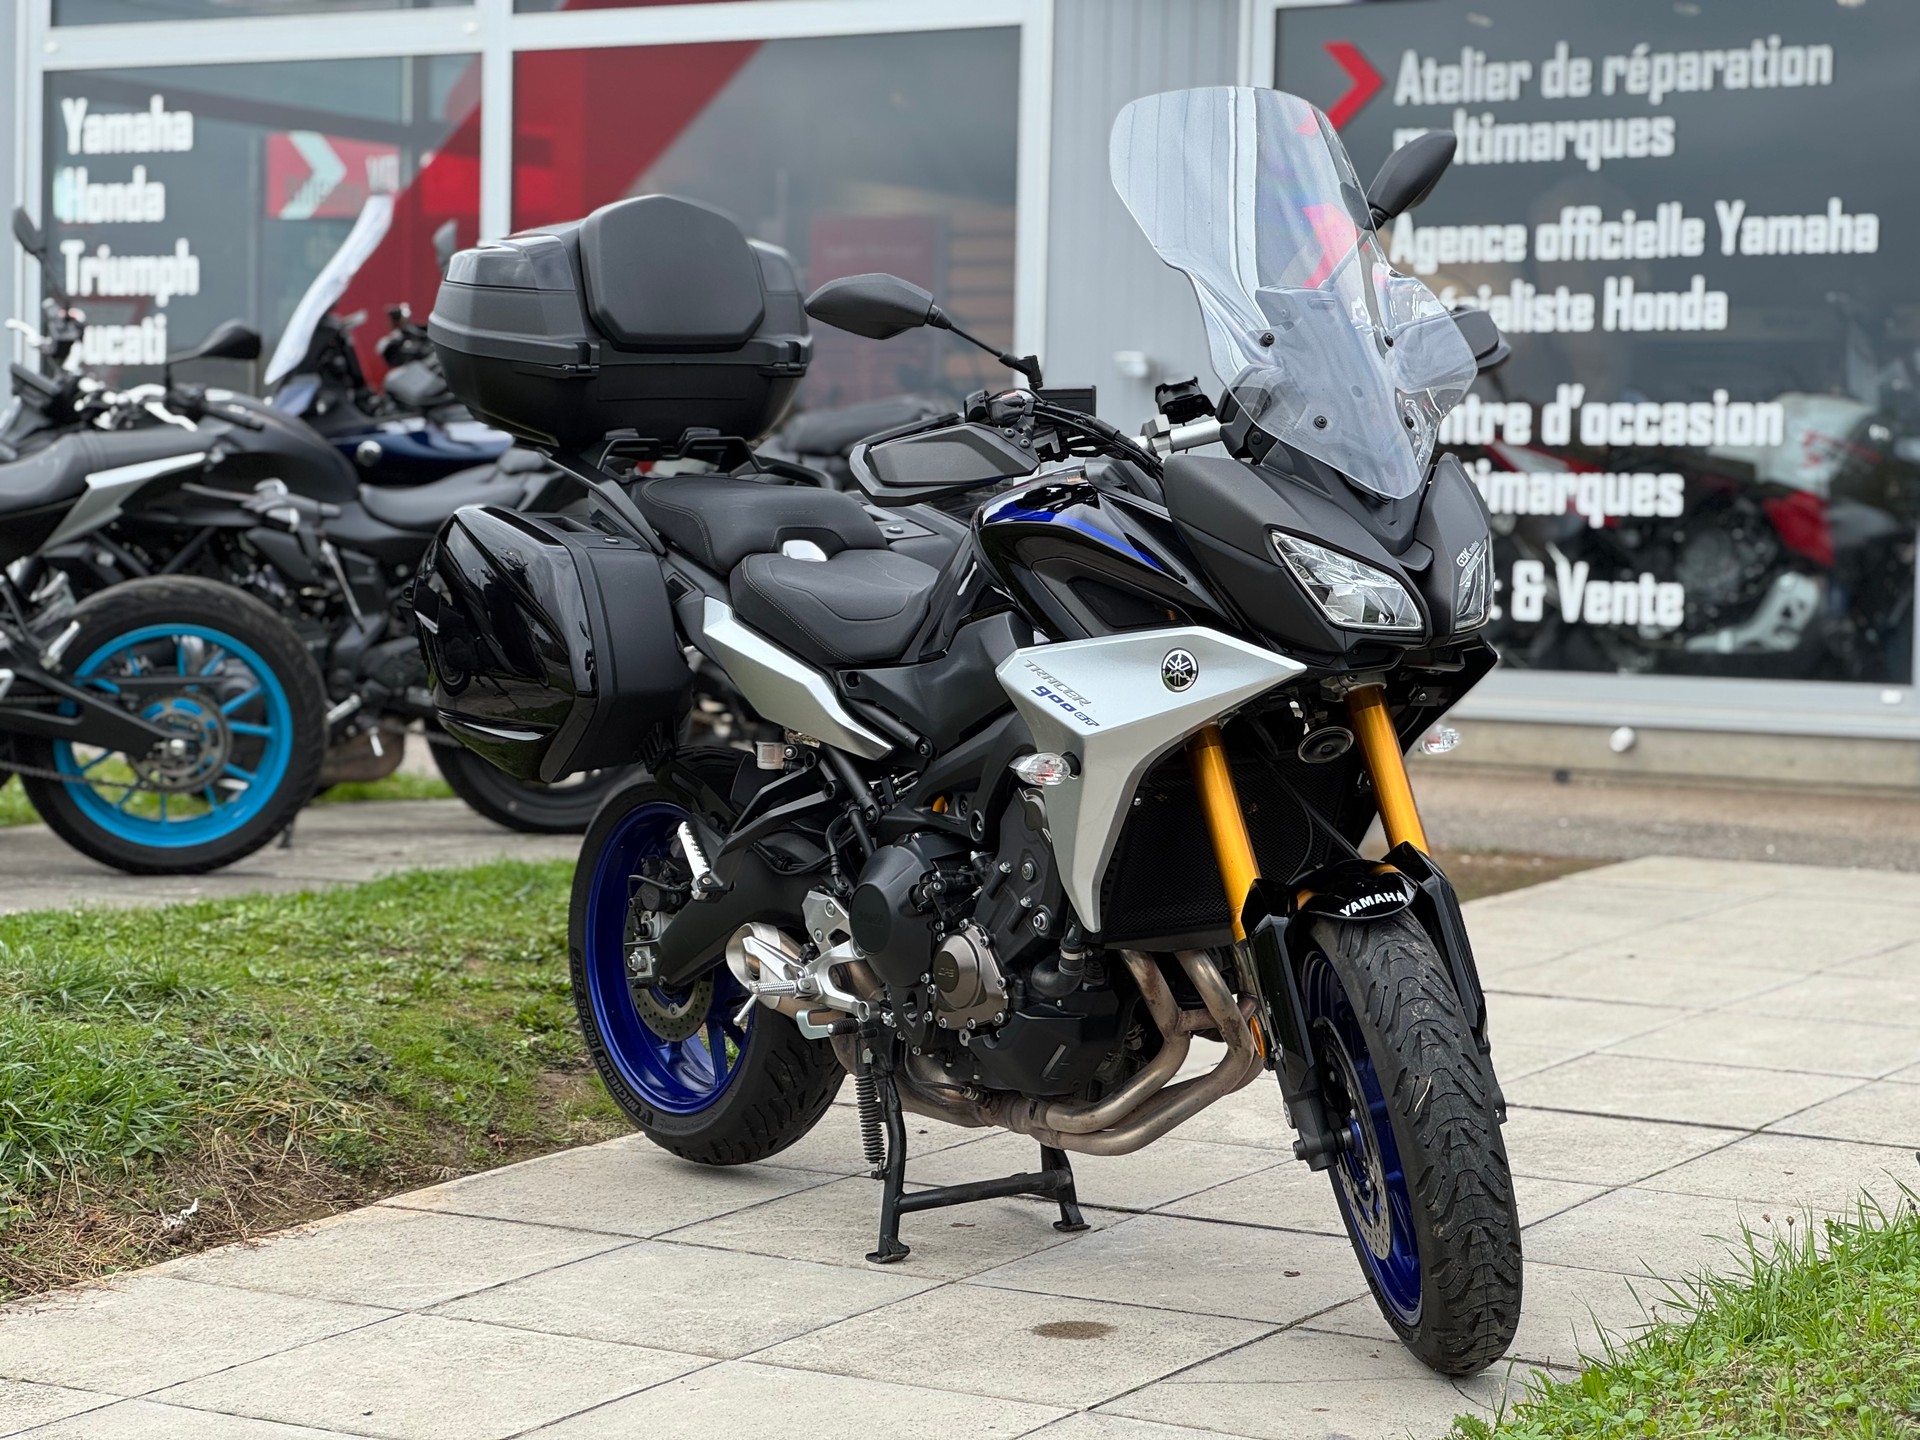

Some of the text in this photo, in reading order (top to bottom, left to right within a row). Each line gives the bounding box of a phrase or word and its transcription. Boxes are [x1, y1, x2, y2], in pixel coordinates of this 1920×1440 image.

[1394, 34, 1833, 106] Atelier de réparation
[61, 95, 194, 154] Yamaha
[1392, 108, 1676, 171] ltimarques
[60, 165, 165, 223] Honda
[1389, 198, 1879, 275] Agence officielle Yamaha
[60, 237, 199, 307] Triumph
[1603, 274, 1728, 332] Honda
[82, 312, 167, 366] ucati
[1438, 384, 1784, 446] ntre d'occasion
[1511, 560, 1546, 622] &
[1553, 559, 1685, 627] Vente
[1024, 659, 1092, 707] TRACER
[1031, 686, 1100, 727] 900 GT
[1339, 890, 1407, 917] YAMAHA
[578, 996, 599, 1046] 180/55
[597, 1054, 639, 1113] MICHELIN
